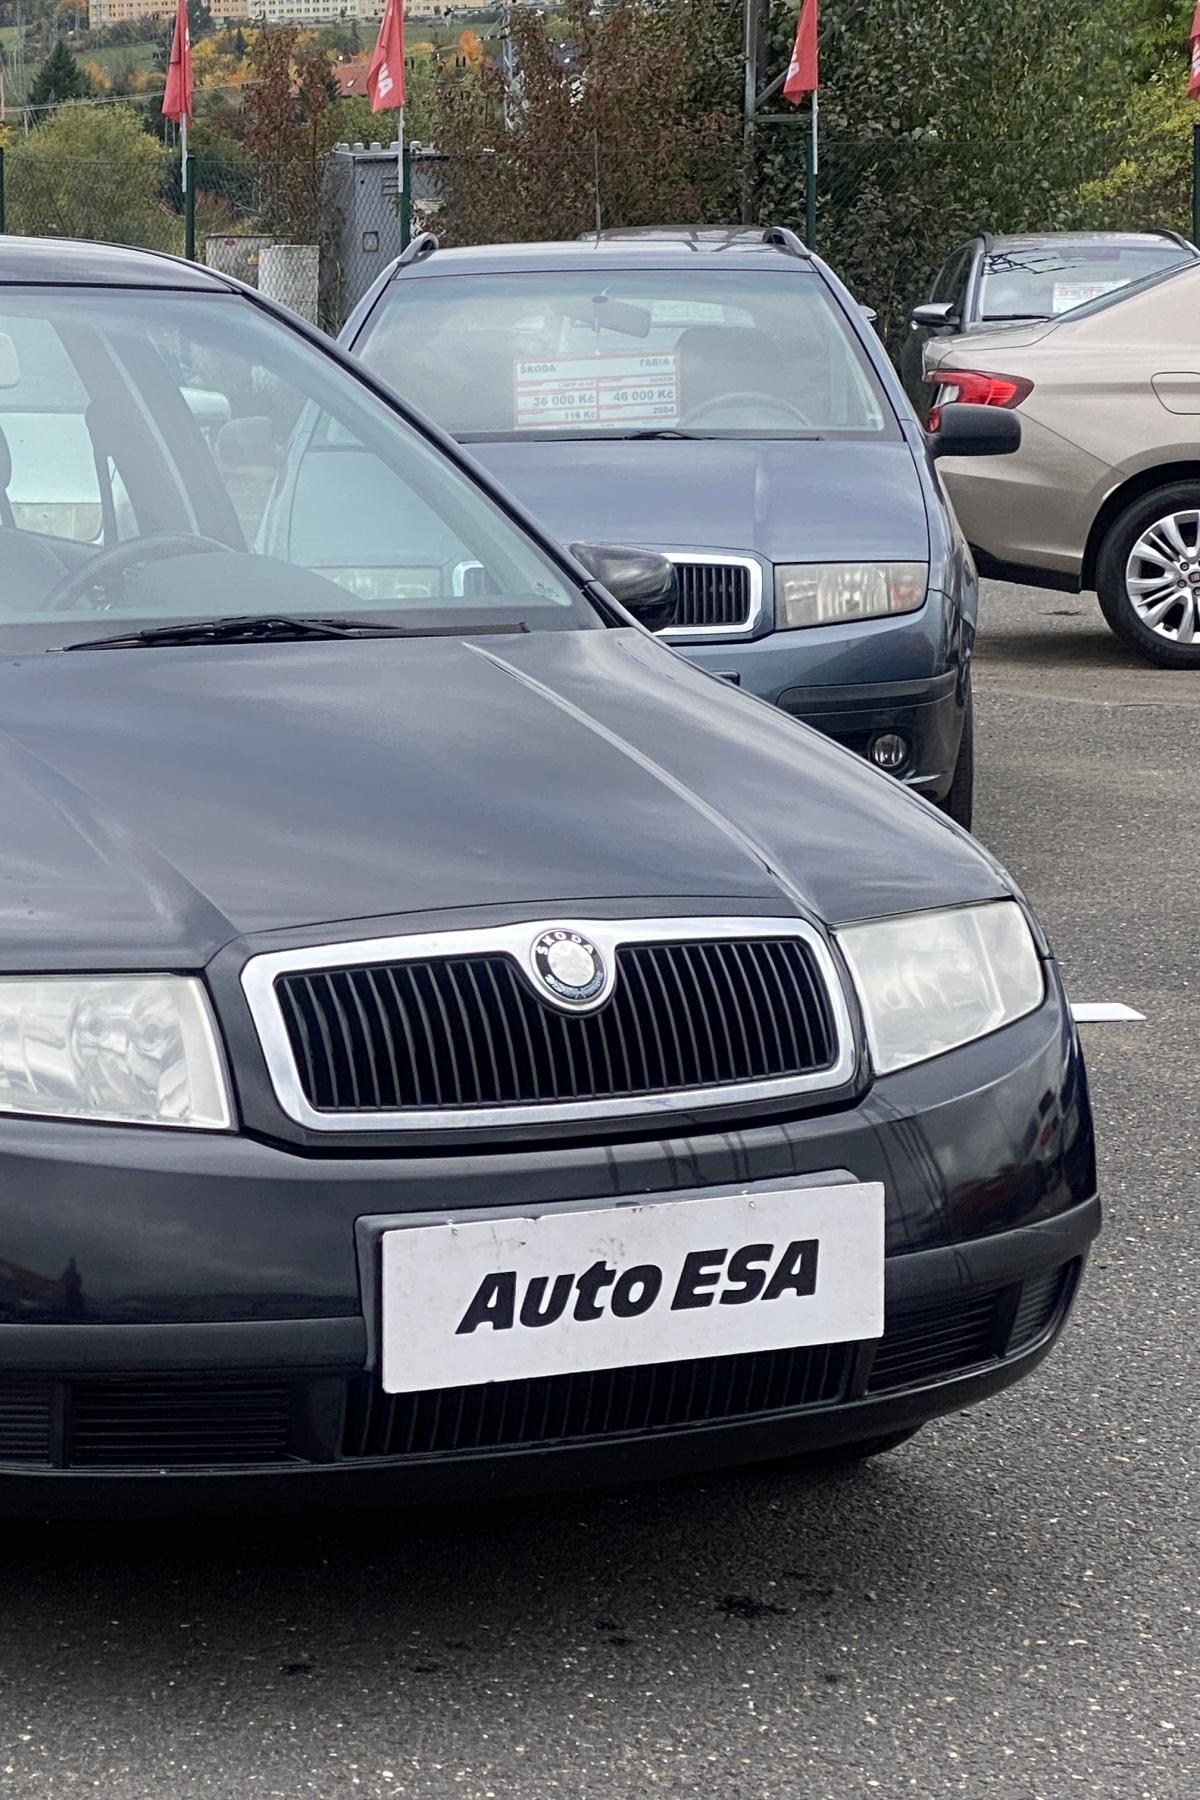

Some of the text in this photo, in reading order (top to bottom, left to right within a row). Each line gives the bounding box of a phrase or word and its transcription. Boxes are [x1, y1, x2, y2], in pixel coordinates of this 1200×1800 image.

[551, 395, 575, 406] 000
[578, 393, 595, 404] Kč
[631, 390, 654, 401] 000
[657, 388, 674, 399] Kč
[455, 1239, 820, 1335] Auto ESA
